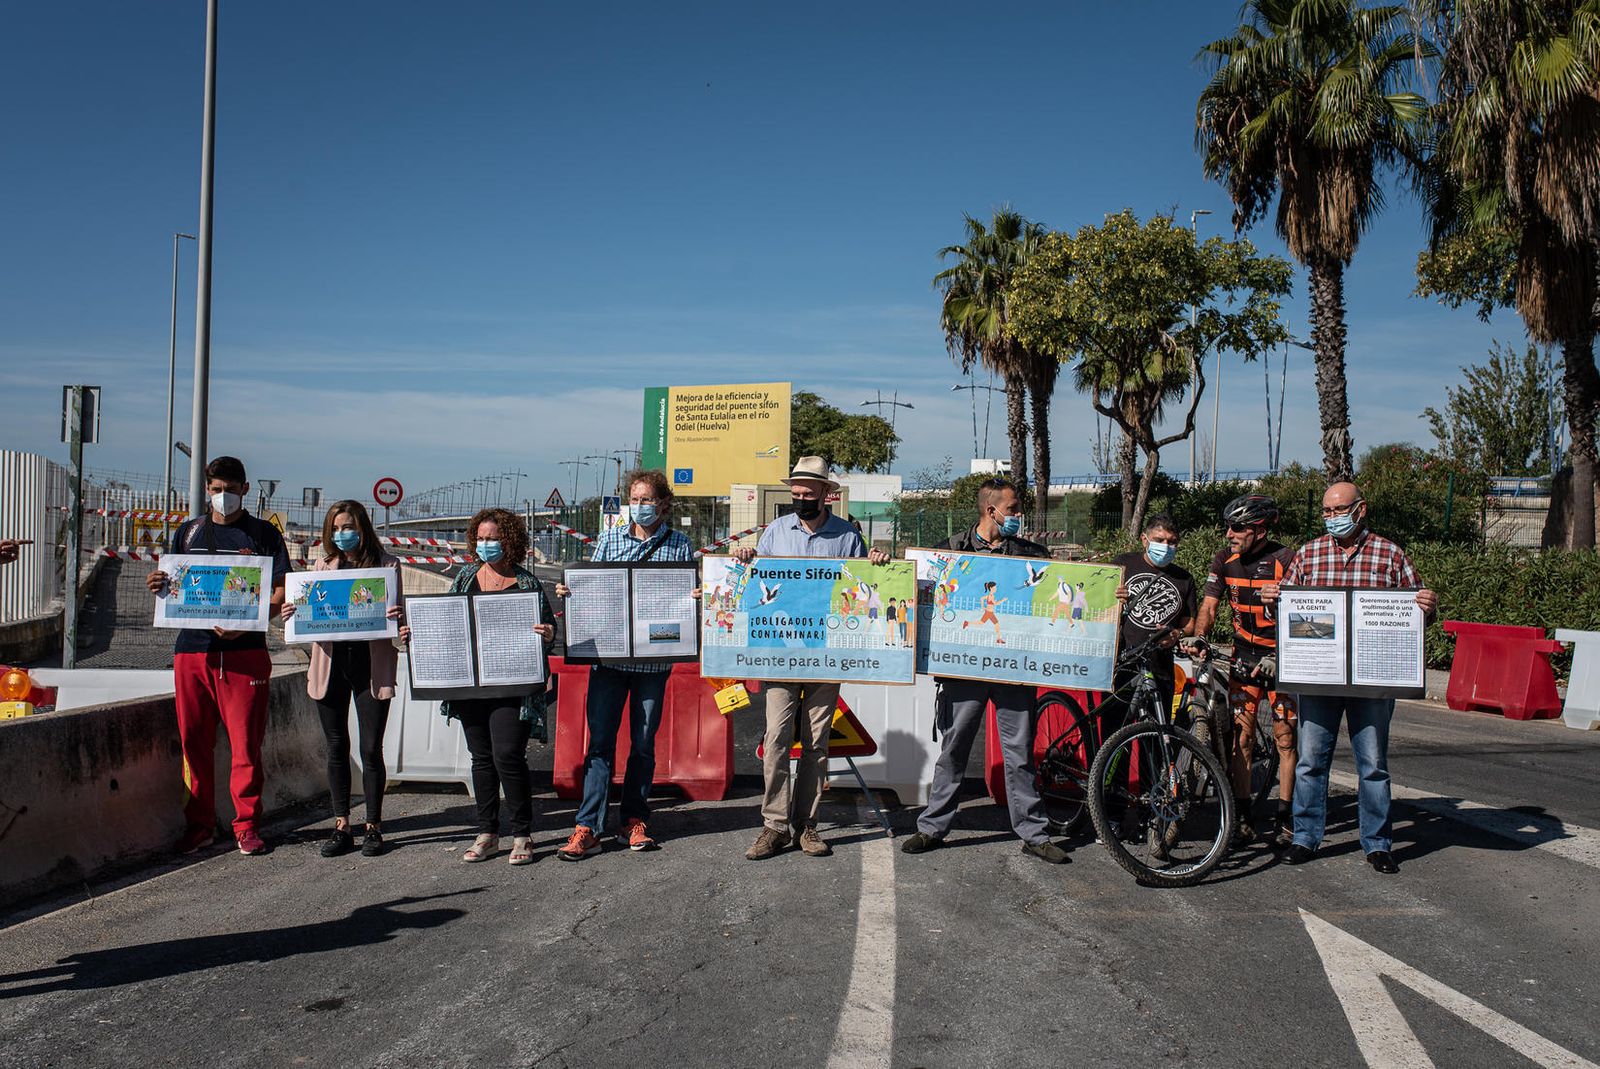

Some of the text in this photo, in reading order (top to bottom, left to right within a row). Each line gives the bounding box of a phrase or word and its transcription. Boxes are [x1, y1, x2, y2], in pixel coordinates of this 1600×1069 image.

[676, 394, 702, 404] Mejora
[704, 393, 714, 401] de
[715, 393, 723, 401] la
[724, 391, 762, 400] eficiencia
[675, 400, 779, 413] seguridad del puente sifón
[675, 412, 685, 421] de
[686, 412, 708, 421] Santa
[710, 411, 736, 420] Eulalia
[749, 411, 757, 419] el
[758, 411, 770, 419] río
[675, 421, 730, 432] Odiel (Huelva)
[751, 567, 842, 580] Puente Sifón
[751, 616, 825, 627] ¡OBLIGADOS A
[751, 630, 824, 640] CONTAMINAR!
[736, 653, 881, 671] Puente para la gente
[982, 655, 1018, 670] para
[1023, 655, 1037, 671] la
[1042, 661, 1089, 677] gente
